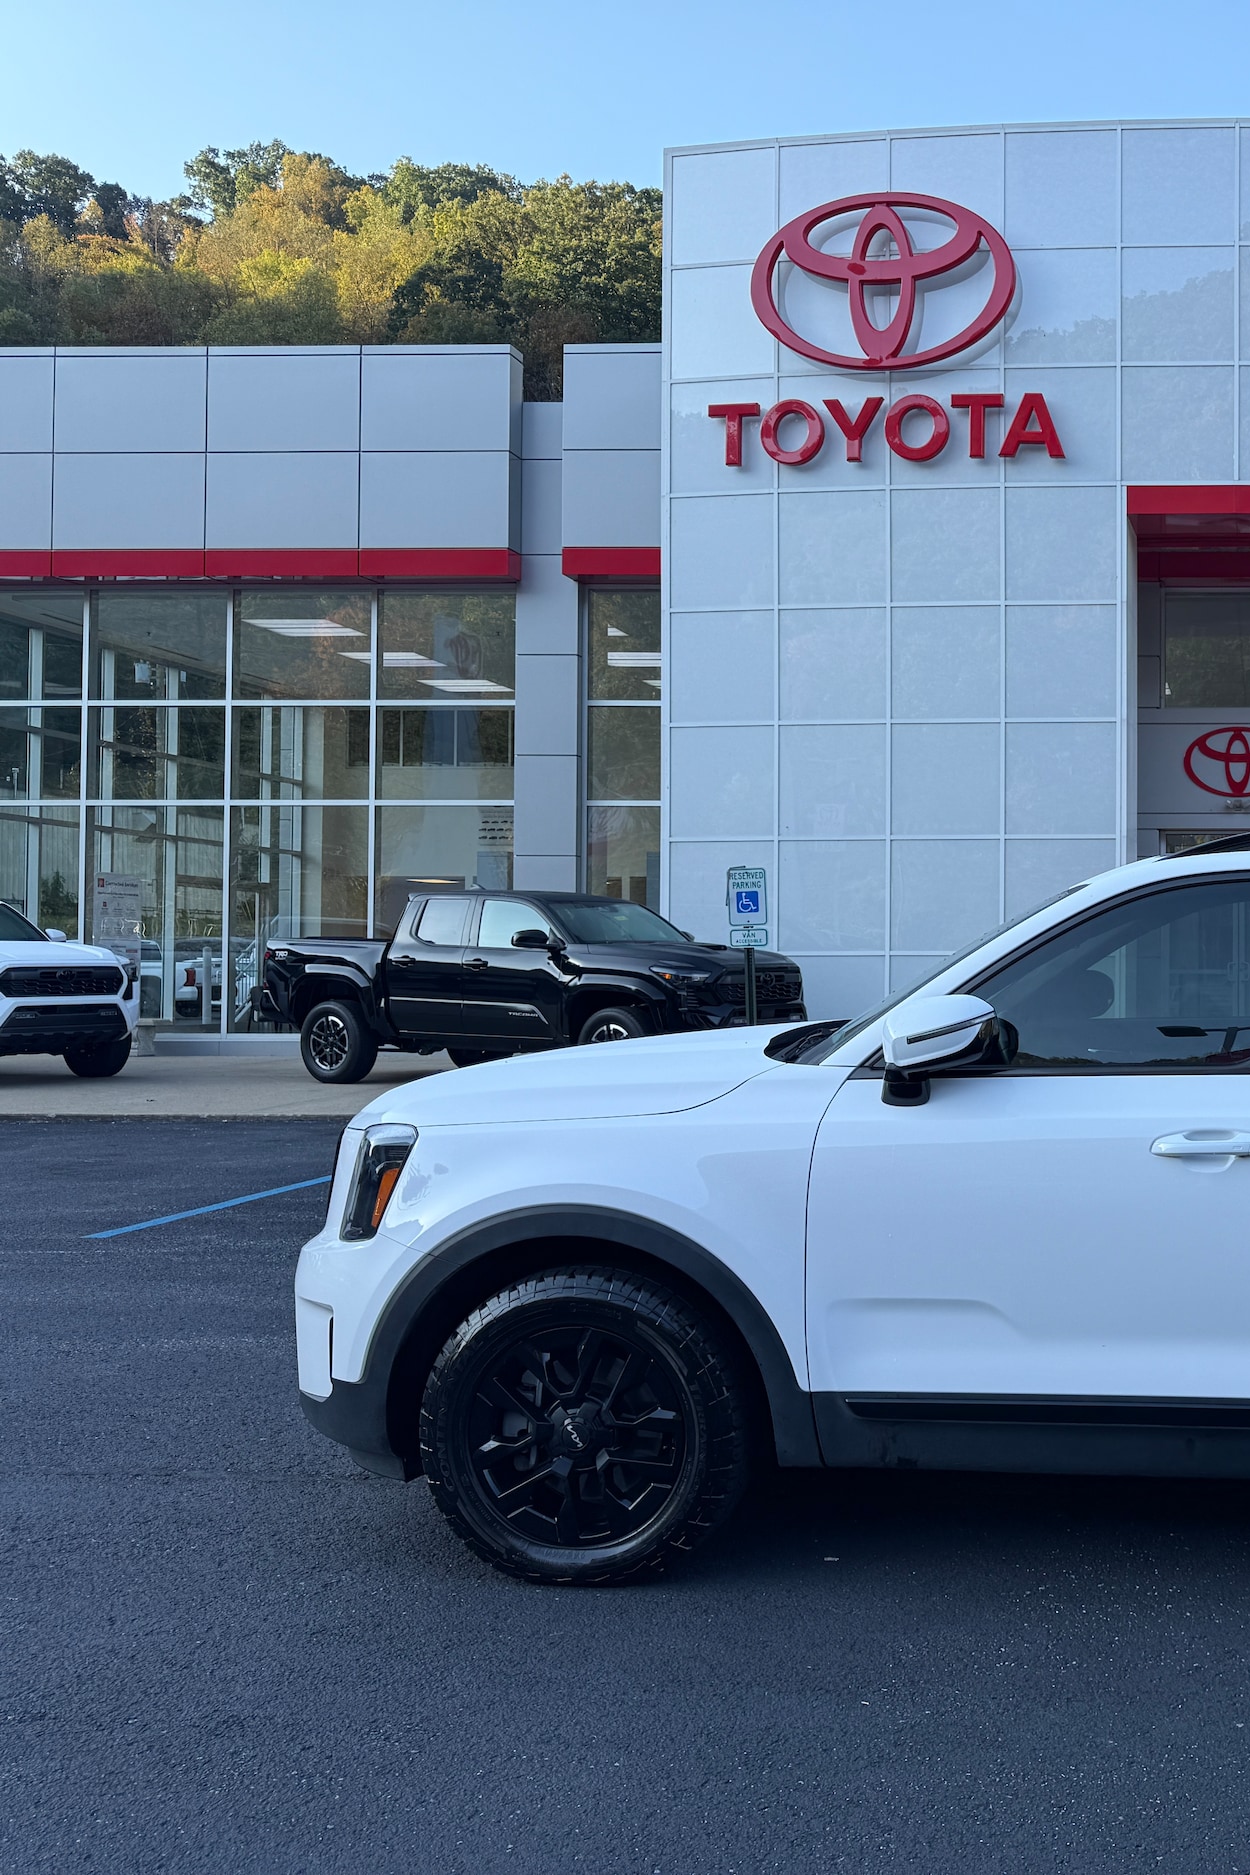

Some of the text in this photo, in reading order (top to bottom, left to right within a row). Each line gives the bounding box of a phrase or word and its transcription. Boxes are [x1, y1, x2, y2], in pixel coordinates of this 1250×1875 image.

[708, 393, 1065, 467] TOYOTA
[729, 871, 764, 880] RESERVED
[732, 880, 762, 889] PARKING
